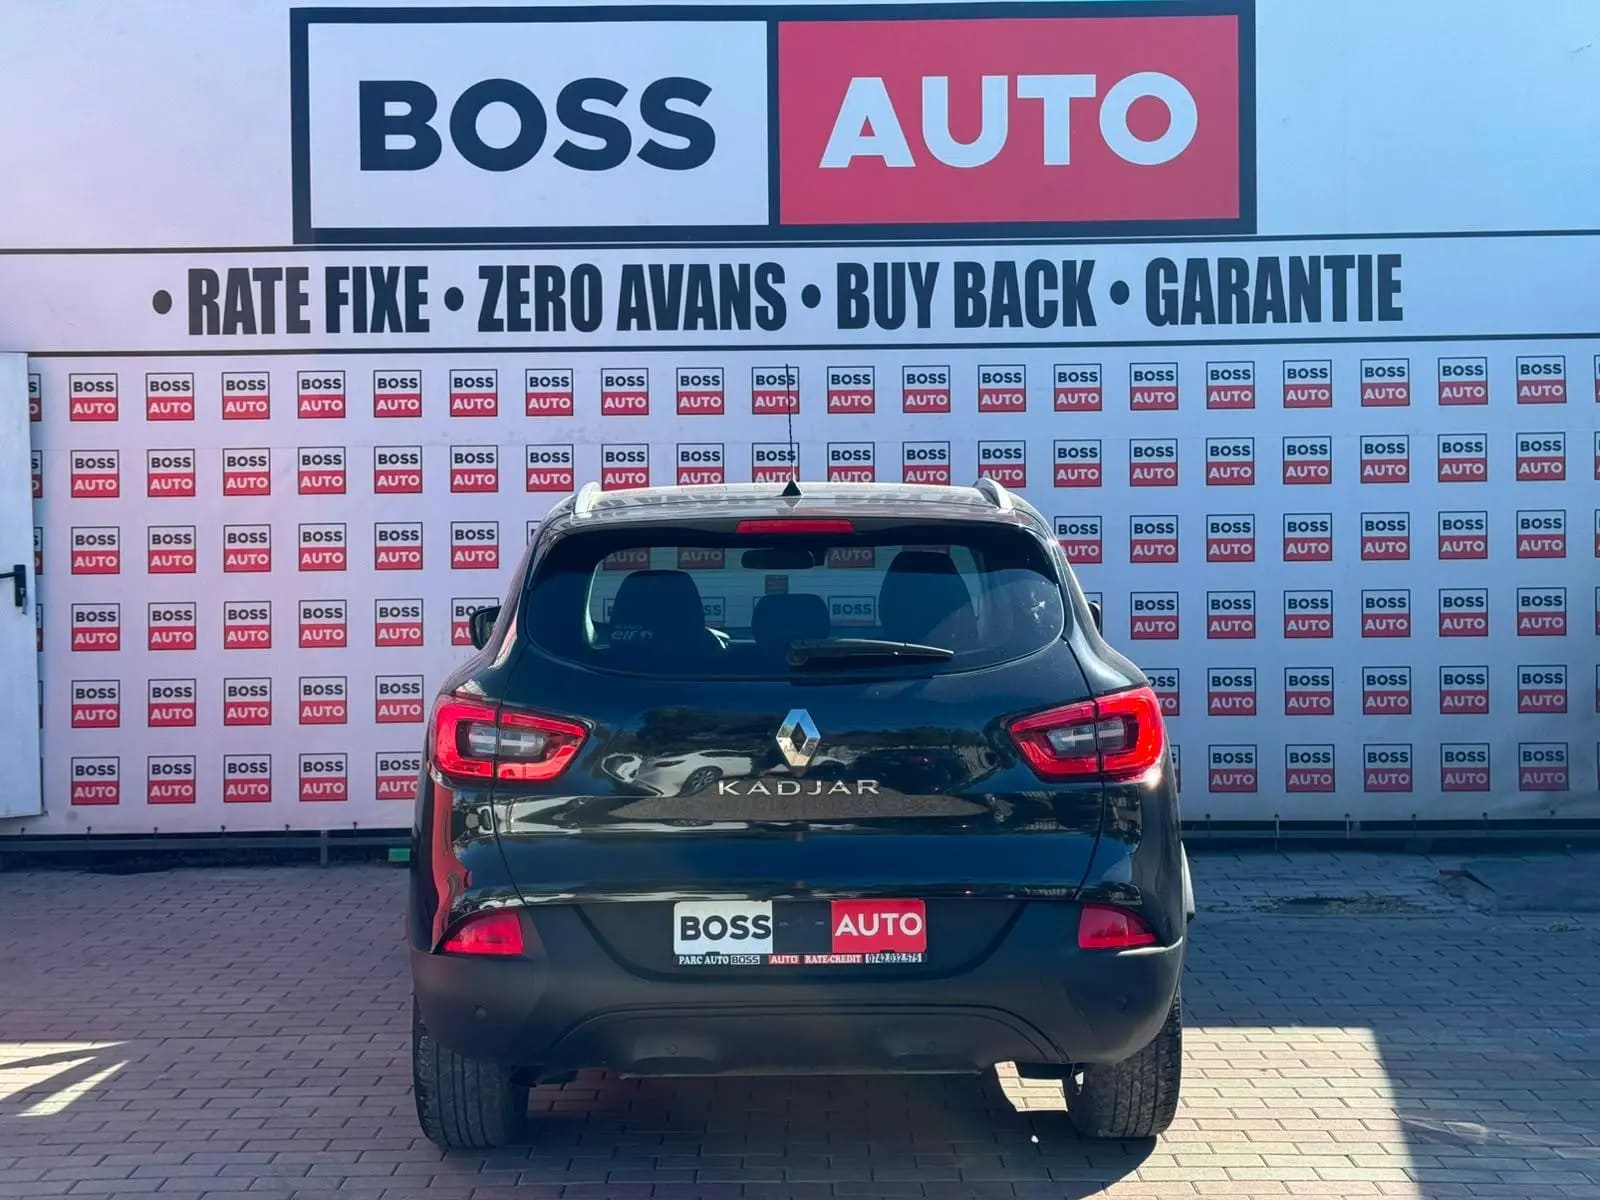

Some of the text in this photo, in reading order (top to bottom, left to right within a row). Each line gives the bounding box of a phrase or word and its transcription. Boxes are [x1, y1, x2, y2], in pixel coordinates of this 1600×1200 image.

[359, 72, 1197, 172] BOSS AUTO
[189, 254, 1404, 336] RATE FIXE ZERO AVANS BUY BACK GARANTIE
[1210, 369, 1251, 380] BOSS
[1287, 368, 1328, 379] BOSS
[1442, 365, 1484, 376] BOSS
[1520, 363, 1562, 375] BOSS
[529, 376, 570, 387] BOSS
[605, 376, 645, 387] BOSS
[680, 375, 720, 386] BOSS
[831, 374, 871, 385] BOSS
[906, 373, 946, 384] BOSS
[982, 372, 1022, 384] BOSS
[1134, 370, 1174, 382] BOSS
[73, 381, 114, 392] BOSS
[226, 379, 266, 391] BOSS
[301, 378, 342, 390] BOSS
[377, 377, 418, 389] BOSS
[1209, 390, 1252, 402] AUTO
[1286, 389, 1329, 401] AUTO
[1441, 386, 1485, 398] AUTO
[1520, 385, 1563, 397] AUTO
[604, 397, 646, 408] AUTO
[679, 396, 722, 408] AUTO
[830, 395, 872, 406] AUTO
[906, 394, 948, 406] AUTO
[981, 394, 1023, 405] AUTO
[1133, 392, 1175, 403] AUTO
[72, 402, 115, 414] AUTO
[225, 401, 267, 412] AUTO
[300, 400, 343, 411] AUTO
[376, 399, 419, 410] AUTO
[528, 398, 571, 409] AUTO
[1210, 445, 1251, 456] BOSS
[1364, 443, 1405, 454] BOSS
[1442, 441, 1483, 453] BOSS
[1520, 440, 1562, 452] BOSS
[530, 452, 570, 463] BOSS
[605, 451, 645, 462] BOSS
[681, 451, 720, 462] BOSS
[831, 450, 871, 461] BOSS
[906, 449, 947, 460] BOSS
[982, 448, 1022, 459] BOSS
[1058, 447, 1098, 458] BOSS
[1134, 446, 1174, 458] BOSS
[151, 457, 191, 468] BOSS
[227, 456, 267, 467] BOSS
[302, 454, 342, 466] BOSS
[454, 452, 494, 464] BOSS
[1133, 468, 1175, 479] AUTO
[1209, 467, 1252, 478] AUTO
[1363, 464, 1406, 476] AUTO
[1441, 463, 1484, 475] AUTO
[1519, 462, 1563, 474] AUTO
[453, 474, 496, 485] AUTO
[529, 473, 571, 485] AUTO
[604, 472, 646, 484] AUTO
[679, 472, 720, 483] AUTO
[830, 471, 871, 482] AUTO
[906, 471, 948, 482] AUTO
[982, 470, 1023, 480] AUTO
[1056, 468, 1099, 480] AUTO
[150, 478, 193, 490] AUTO
[226, 477, 268, 489] AUTO
[300, 476, 343, 487] AUTO
[1134, 523, 1174, 534] BOSS
[1287, 521, 1328, 533] BOSS
[1365, 520, 1406, 531] BOSS
[1442, 519, 1484, 530] BOSS
[75, 534, 116, 546] BOSS
[152, 533, 192, 545] BOSS
[227, 532, 267, 544] BOSS
[379, 530, 419, 541] BOSS
[455, 529, 495, 540] BOSS
[1133, 544, 1175, 556] AUTO
[1286, 542, 1329, 554] AUTO
[1364, 541, 1407, 553] AUTO
[1441, 540, 1485, 552] AUTO
[151, 555, 193, 566] AUTO
[226, 554, 269, 565] AUTO
[377, 551, 420, 563] AUTO
[453, 550, 496, 562] AUTO
[681, 551, 721, 560] AUTO
[830, 550, 872, 560] AUTO
[74, 556, 117, 567] AUTO
[1134, 600, 1175, 611] BOSS
[1288, 598, 1329, 609] BOSS
[1366, 597, 1406, 608] BOSS
[1443, 596, 1484, 608] BOSS
[303, 608, 343, 619] BOSS
[379, 606, 420, 618] BOSS
[832, 604, 872, 615] BOSS
[75, 611, 116, 622] BOSS
[152, 610, 192, 621] BOSS
[1134, 621, 1176, 632] AUTO
[1287, 619, 1330, 631] AUTO
[1365, 619, 1408, 630] AUTO
[1442, 618, 1485, 629] AUTO
[74, 632, 118, 644] AUTO
[151, 631, 194, 643] AUTO
[302, 629, 344, 640] AUTO
[378, 627, 421, 639] AUTO
[1212, 675, 1252, 687] BOSS
[1366, 674, 1407, 686] BOSS
[1444, 673, 1485, 685] BOSS
[1522, 673, 1563, 684] BOSS
[75, 688, 116, 699] BOSS
[152, 686, 192, 698] BOSS
[303, 684, 343, 696] BOSS
[379, 683, 420, 694] BOSS
[1211, 697, 1254, 708] AUTO
[1365, 696, 1409, 707] AUTO
[1442, 695, 1486, 707] AUTO
[1520, 694, 1564, 706] AUTO
[74, 709, 118, 721] AUTO
[151, 708, 194, 720] AUTO
[302, 705, 344, 717] AUTO
[378, 704, 421, 716] AUTO
[1213, 752, 1253, 764] BOSS
[1289, 752, 1331, 763] BOSS
[1445, 751, 1486, 762] BOSS
[1523, 750, 1565, 762] BOSS
[75, 764, 116, 776] BOSS
[152, 763, 192, 775] BOSS
[228, 762, 268, 774] BOSS
[380, 759, 420, 771] BOSS
[1212, 774, 1255, 785] AUTO
[1289, 774, 1332, 785] AUTO
[1444, 773, 1487, 784] AUTO
[1522, 772, 1566, 784] AUTO
[74, 786, 117, 798] AUTO
[150, 785, 193, 797] AUTO
[226, 784, 269, 796] AUTO
[379, 781, 418, 792] AUTO
[718, 780, 880, 796] KADJAR
[680, 912, 923, 941] BOSS AUTO
[679, 956, 703, 965] PARC
[704, 956, 729, 965] AUTO
[731, 955, 760, 965] BOSS
[770, 955, 799, 964] AUTO
